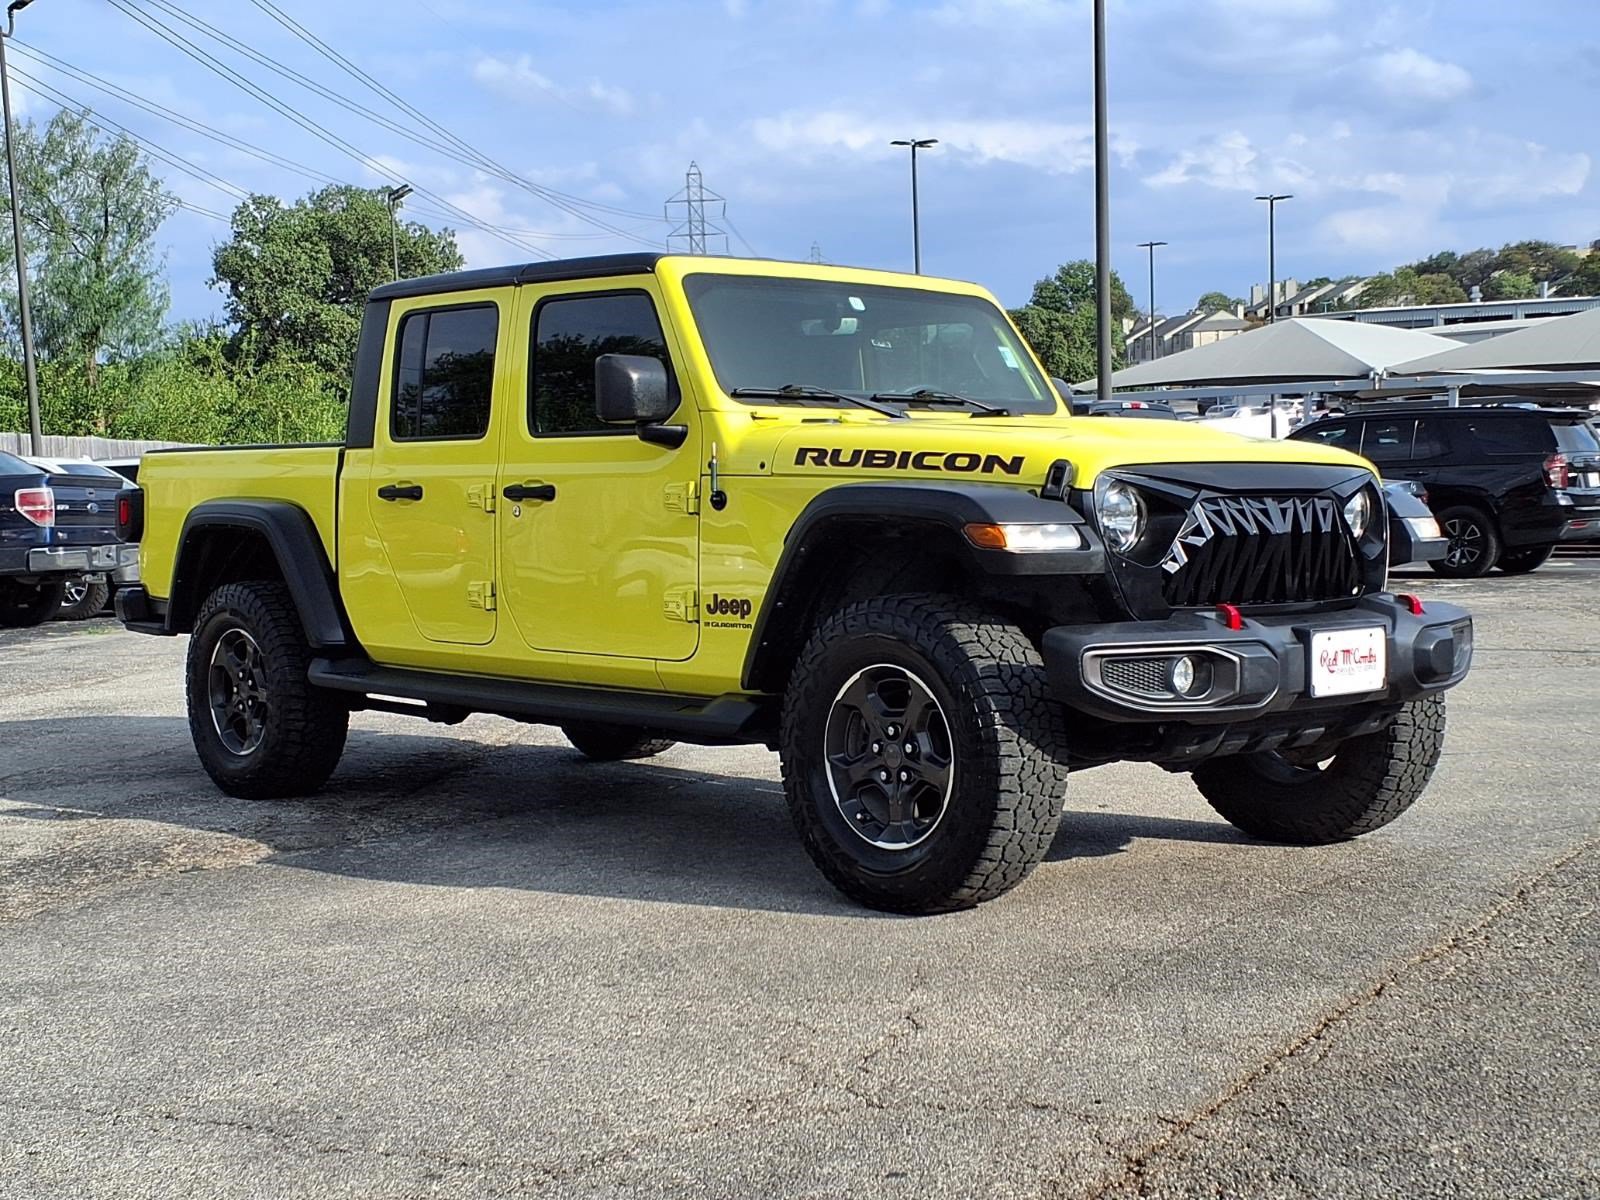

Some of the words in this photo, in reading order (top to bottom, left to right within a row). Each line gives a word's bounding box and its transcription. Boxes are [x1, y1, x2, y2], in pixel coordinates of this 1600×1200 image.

[794, 447, 1025, 475] RUBICON
[706, 593, 752, 620] Jeep
[711, 621, 753, 630] GLADIATOR
[1320, 649, 1338, 673] Red
